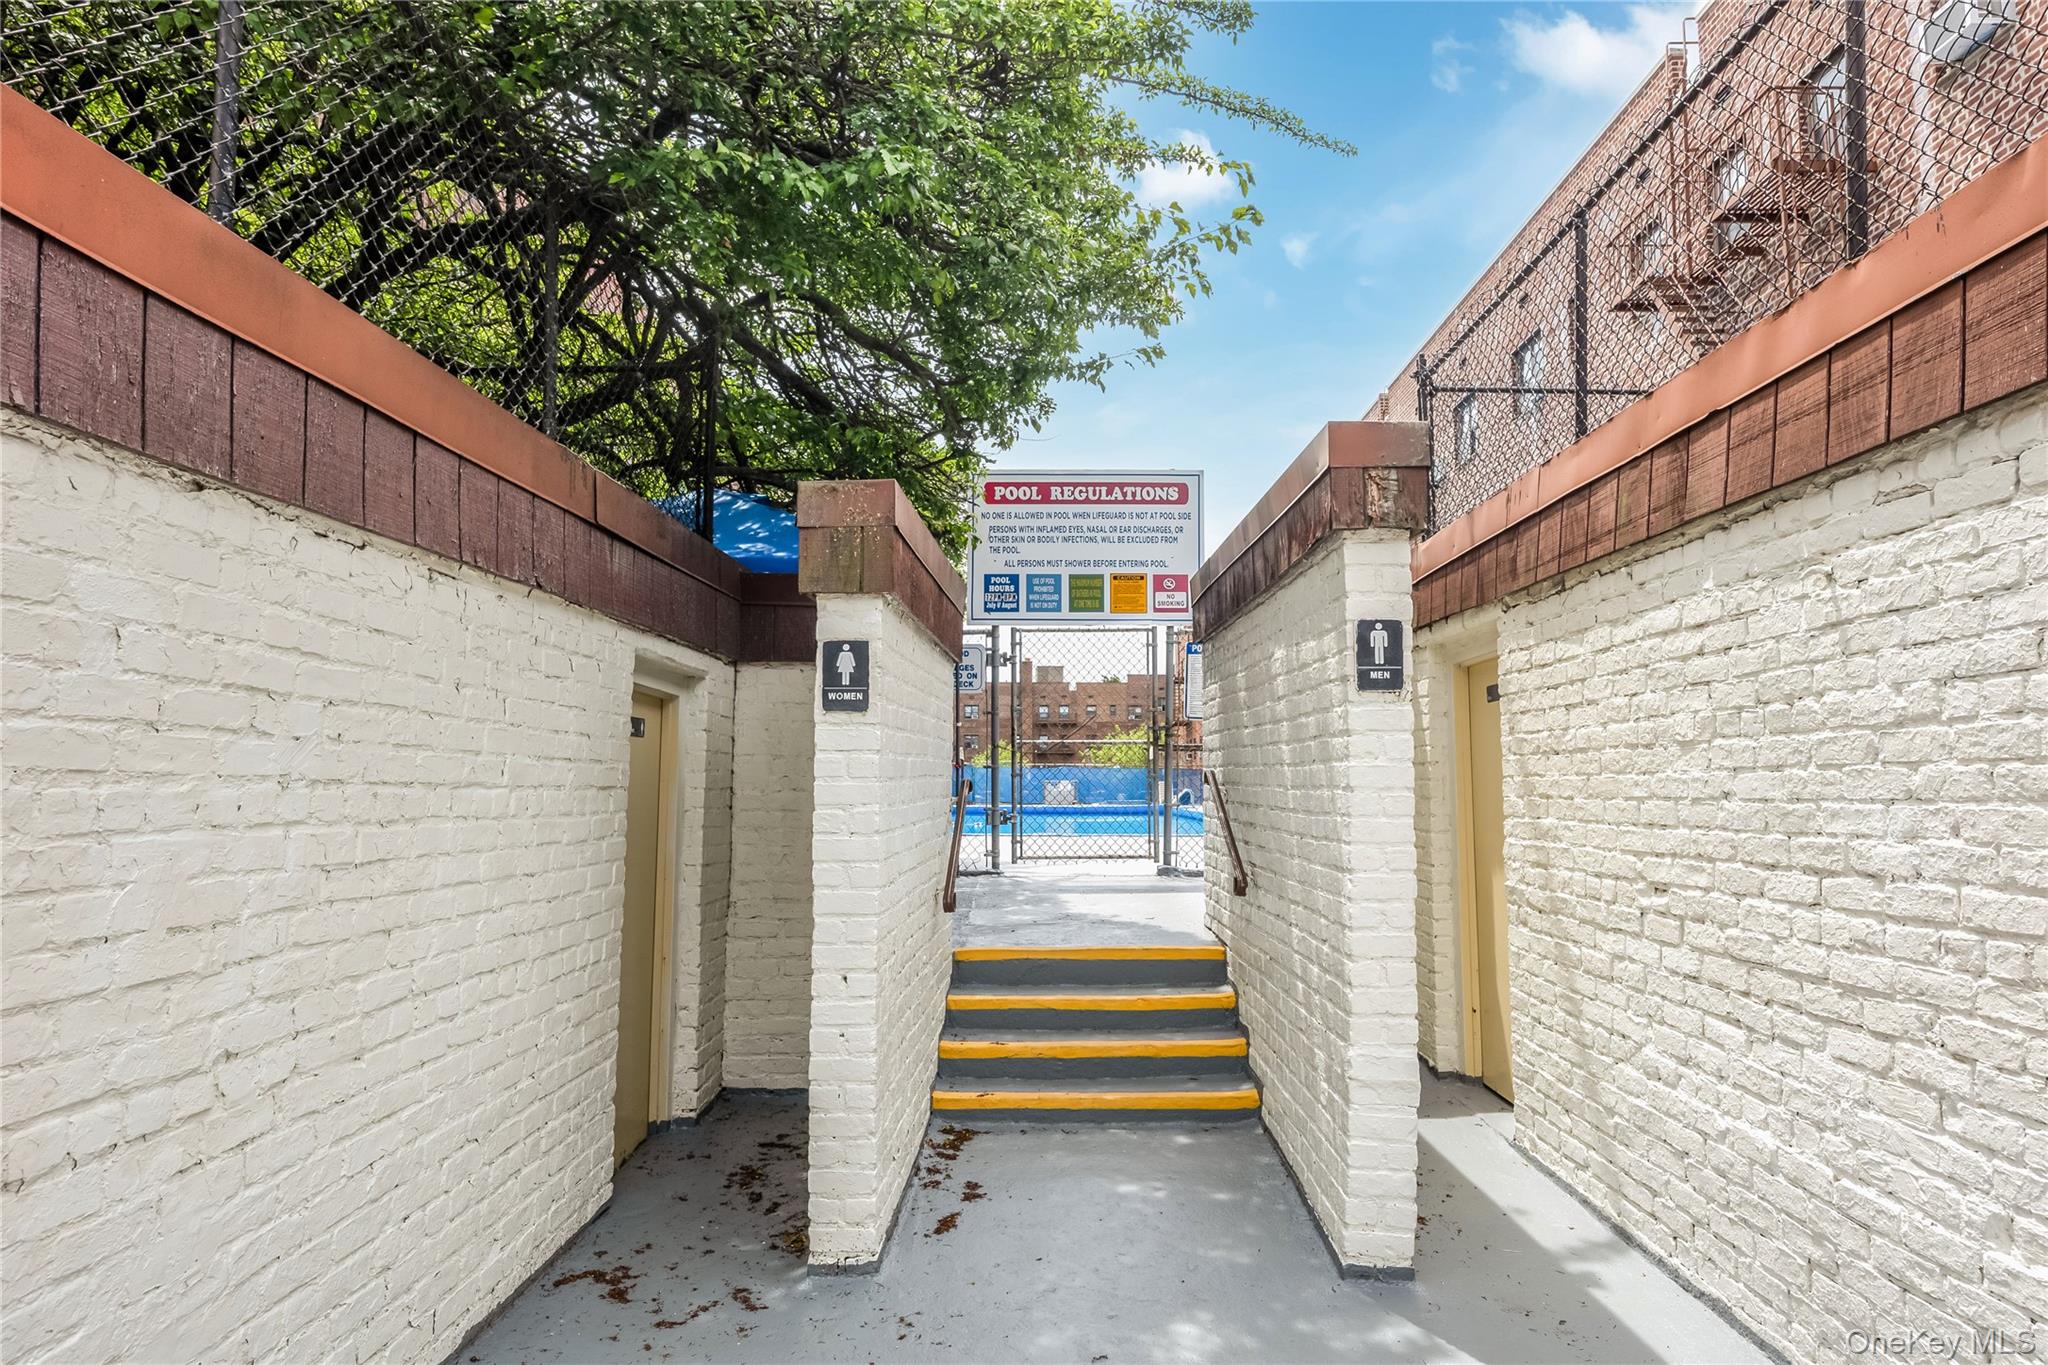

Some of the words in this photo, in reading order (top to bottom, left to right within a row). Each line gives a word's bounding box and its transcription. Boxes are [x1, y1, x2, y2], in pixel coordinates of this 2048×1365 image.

[994, 486, 1042, 500] POOL
[1050, 486, 1179, 500] REGULATIONS
[981, 512, 990, 520] NO
[992, 512, 1005, 520] ONE
[1006, 512, 1012, 520] IS
[1014, 512, 1044, 520] ALLOWED
[1046, 512, 1052, 520] IN
[1054, 512, 1070, 520] POOL
[1072, 512, 1091, 520] WHEN
[1092, 512, 1127, 520] LIFEGUARD
[1128, 512, 1134, 520] IS
[1135, 512, 1148, 520] NOT
[1150, 512, 1158, 520] AT
[1160, 512, 1176, 520] POOL
[1178, 512, 1191, 520] SIDE
[1068, 526, 1086, 534] EYES,
[1133, 526, 1174, 534] DISCHARGES,
[1061, 536, 1099, 544] INFECTIONS,
[1004, 560, 1016, 568] ALL
[1016, 560, 1046, 568] PERSONS
[1047, 560, 1062, 568] MUST
[1063, 560, 1092, 568] SHOWER
[1093, 560, 1117, 568] BEFORE
[1118, 560, 1150, 568] ENTERING
[1151, 560, 1168, 568] POOL.
[1370, 671, 1390, 679] MEN
[828, 692, 863, 700] WOMEN
